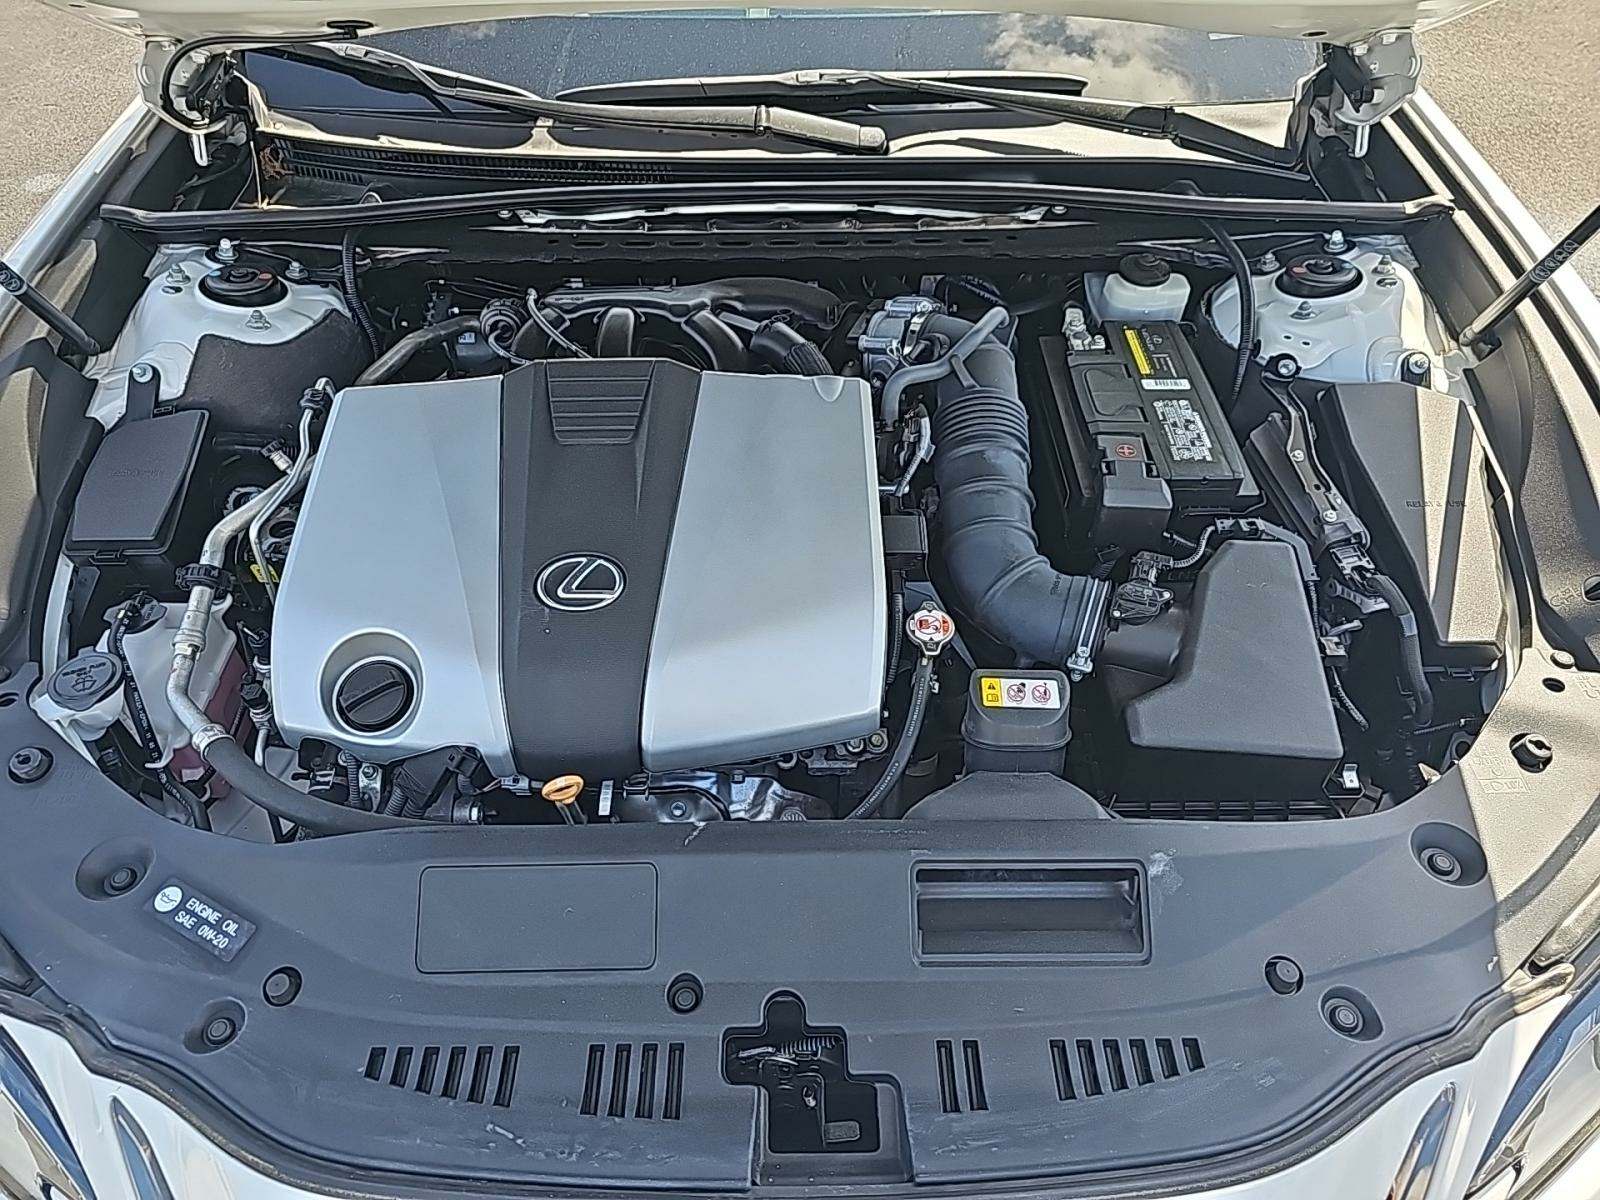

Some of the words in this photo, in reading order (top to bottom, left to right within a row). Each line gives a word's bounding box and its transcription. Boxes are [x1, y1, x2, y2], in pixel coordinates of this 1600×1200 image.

[174, 910, 198, 930] SAE
[197, 924, 229, 949] 0W-20
[185, 897, 222, 925] ENGINE
[221, 919, 239, 937] OIL
